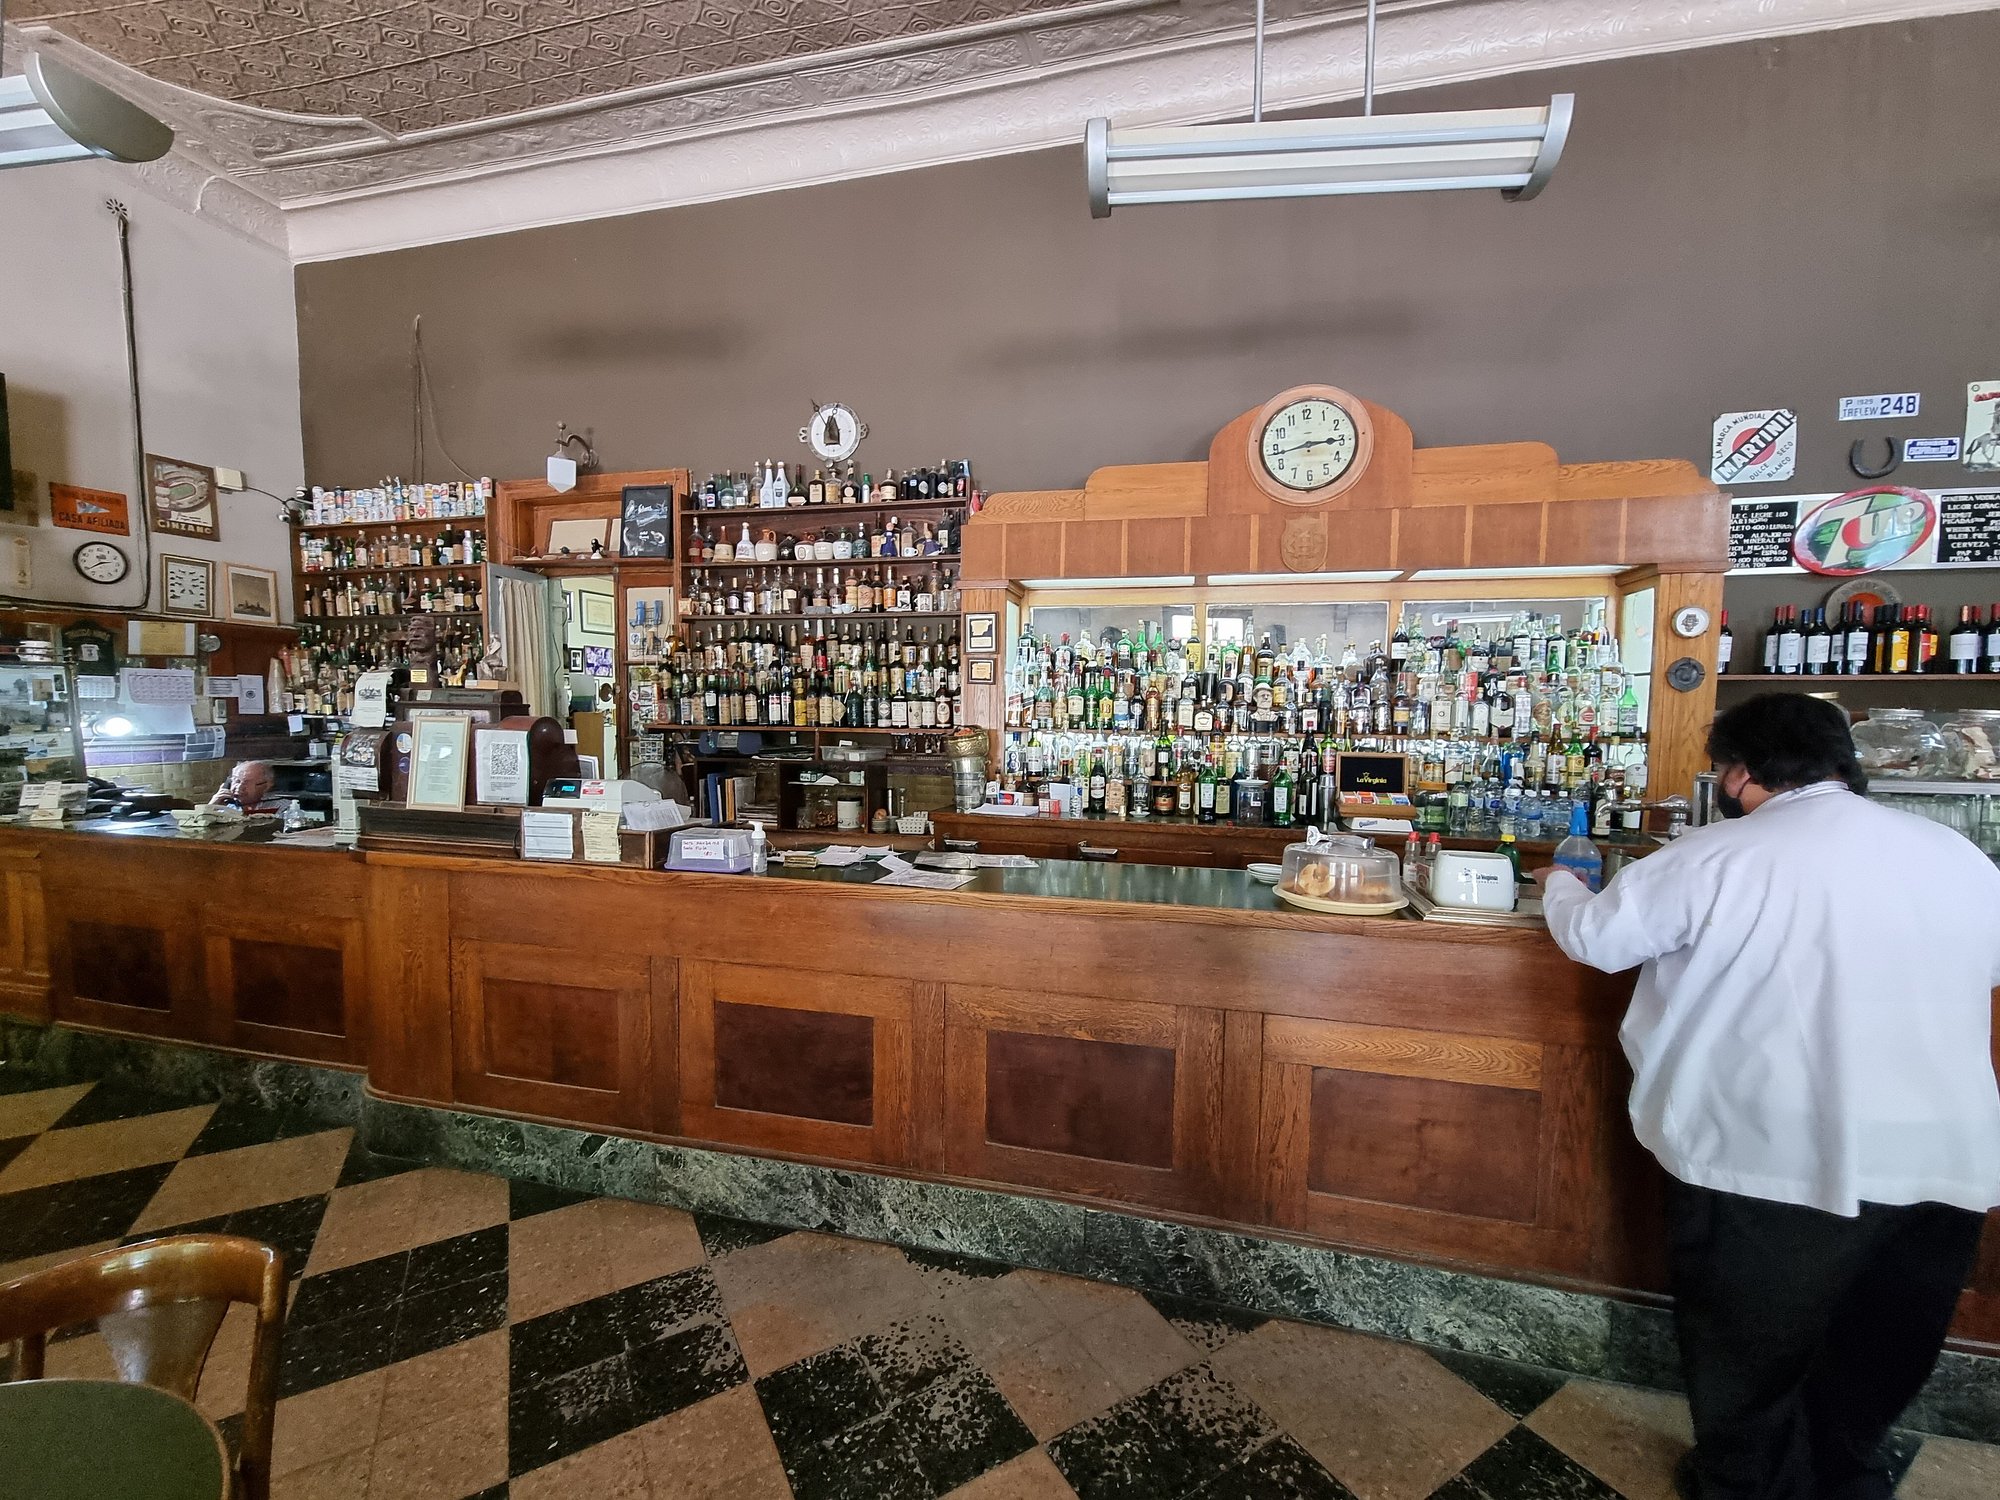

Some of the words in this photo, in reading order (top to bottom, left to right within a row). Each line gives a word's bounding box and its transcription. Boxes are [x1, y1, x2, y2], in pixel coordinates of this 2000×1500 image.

[1842, 406, 1879, 418] TRELEW
[1880, 395, 1916, 416] 248
[1845, 399, 1852, 407] P
[1302, 408, 1312, 420] 12
[1321, 410, 1326, 421] 1
[1732, 413, 1766, 426] MUNDIAL
[1288, 415, 1296, 426] 11
[1333, 419, 1340, 431] 2
[1275, 427, 1286, 439] 10
[1716, 425, 1733, 447] MARCA
[1338, 434, 1345, 446] 3
[1716, 413, 1791, 479] MARTINI
[1272, 443, 1279, 455] 9
[1715, 450, 1723, 459] LA
[1776, 441, 1794, 457] SECO
[1333, 451, 1342, 462] 4
[1278, 458, 1285, 470] 8
[1322, 463, 1330, 475] 5
[1766, 456, 1791, 478] BLANCO
[1291, 467, 1298, 479] 7
[1306, 469, 1313, 481] 6
[1749, 463, 1769, 480] DULCE
[58, 511, 83, 524] CASA
[157, 519, 212, 535] CINZANO
[1951, 541, 1990, 549] CERVEZA
[1364, 777, 1387, 785] Virginia
